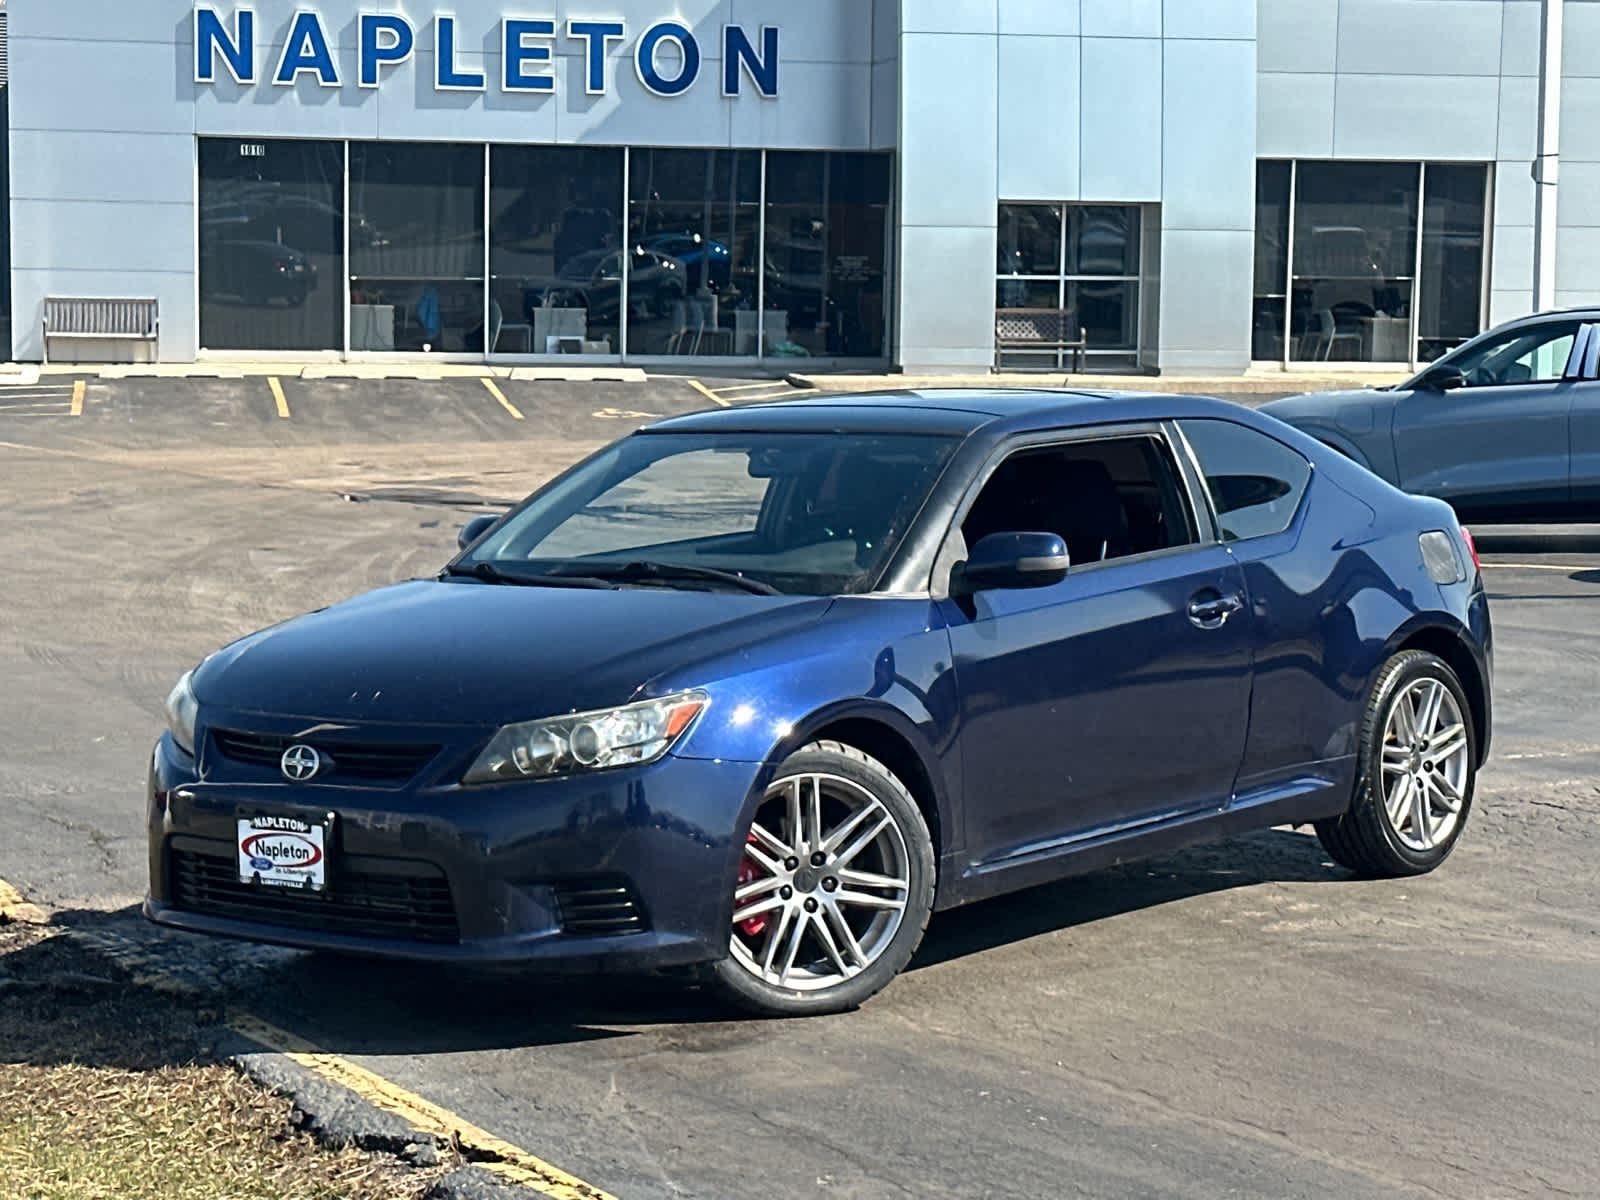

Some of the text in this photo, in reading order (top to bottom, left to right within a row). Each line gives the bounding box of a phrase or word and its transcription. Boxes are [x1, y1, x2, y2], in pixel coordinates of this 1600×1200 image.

[193, 7, 780, 99] NAPLETON
[254, 817, 305, 831] NAPLETON
[255, 840, 309, 860] Napleton
